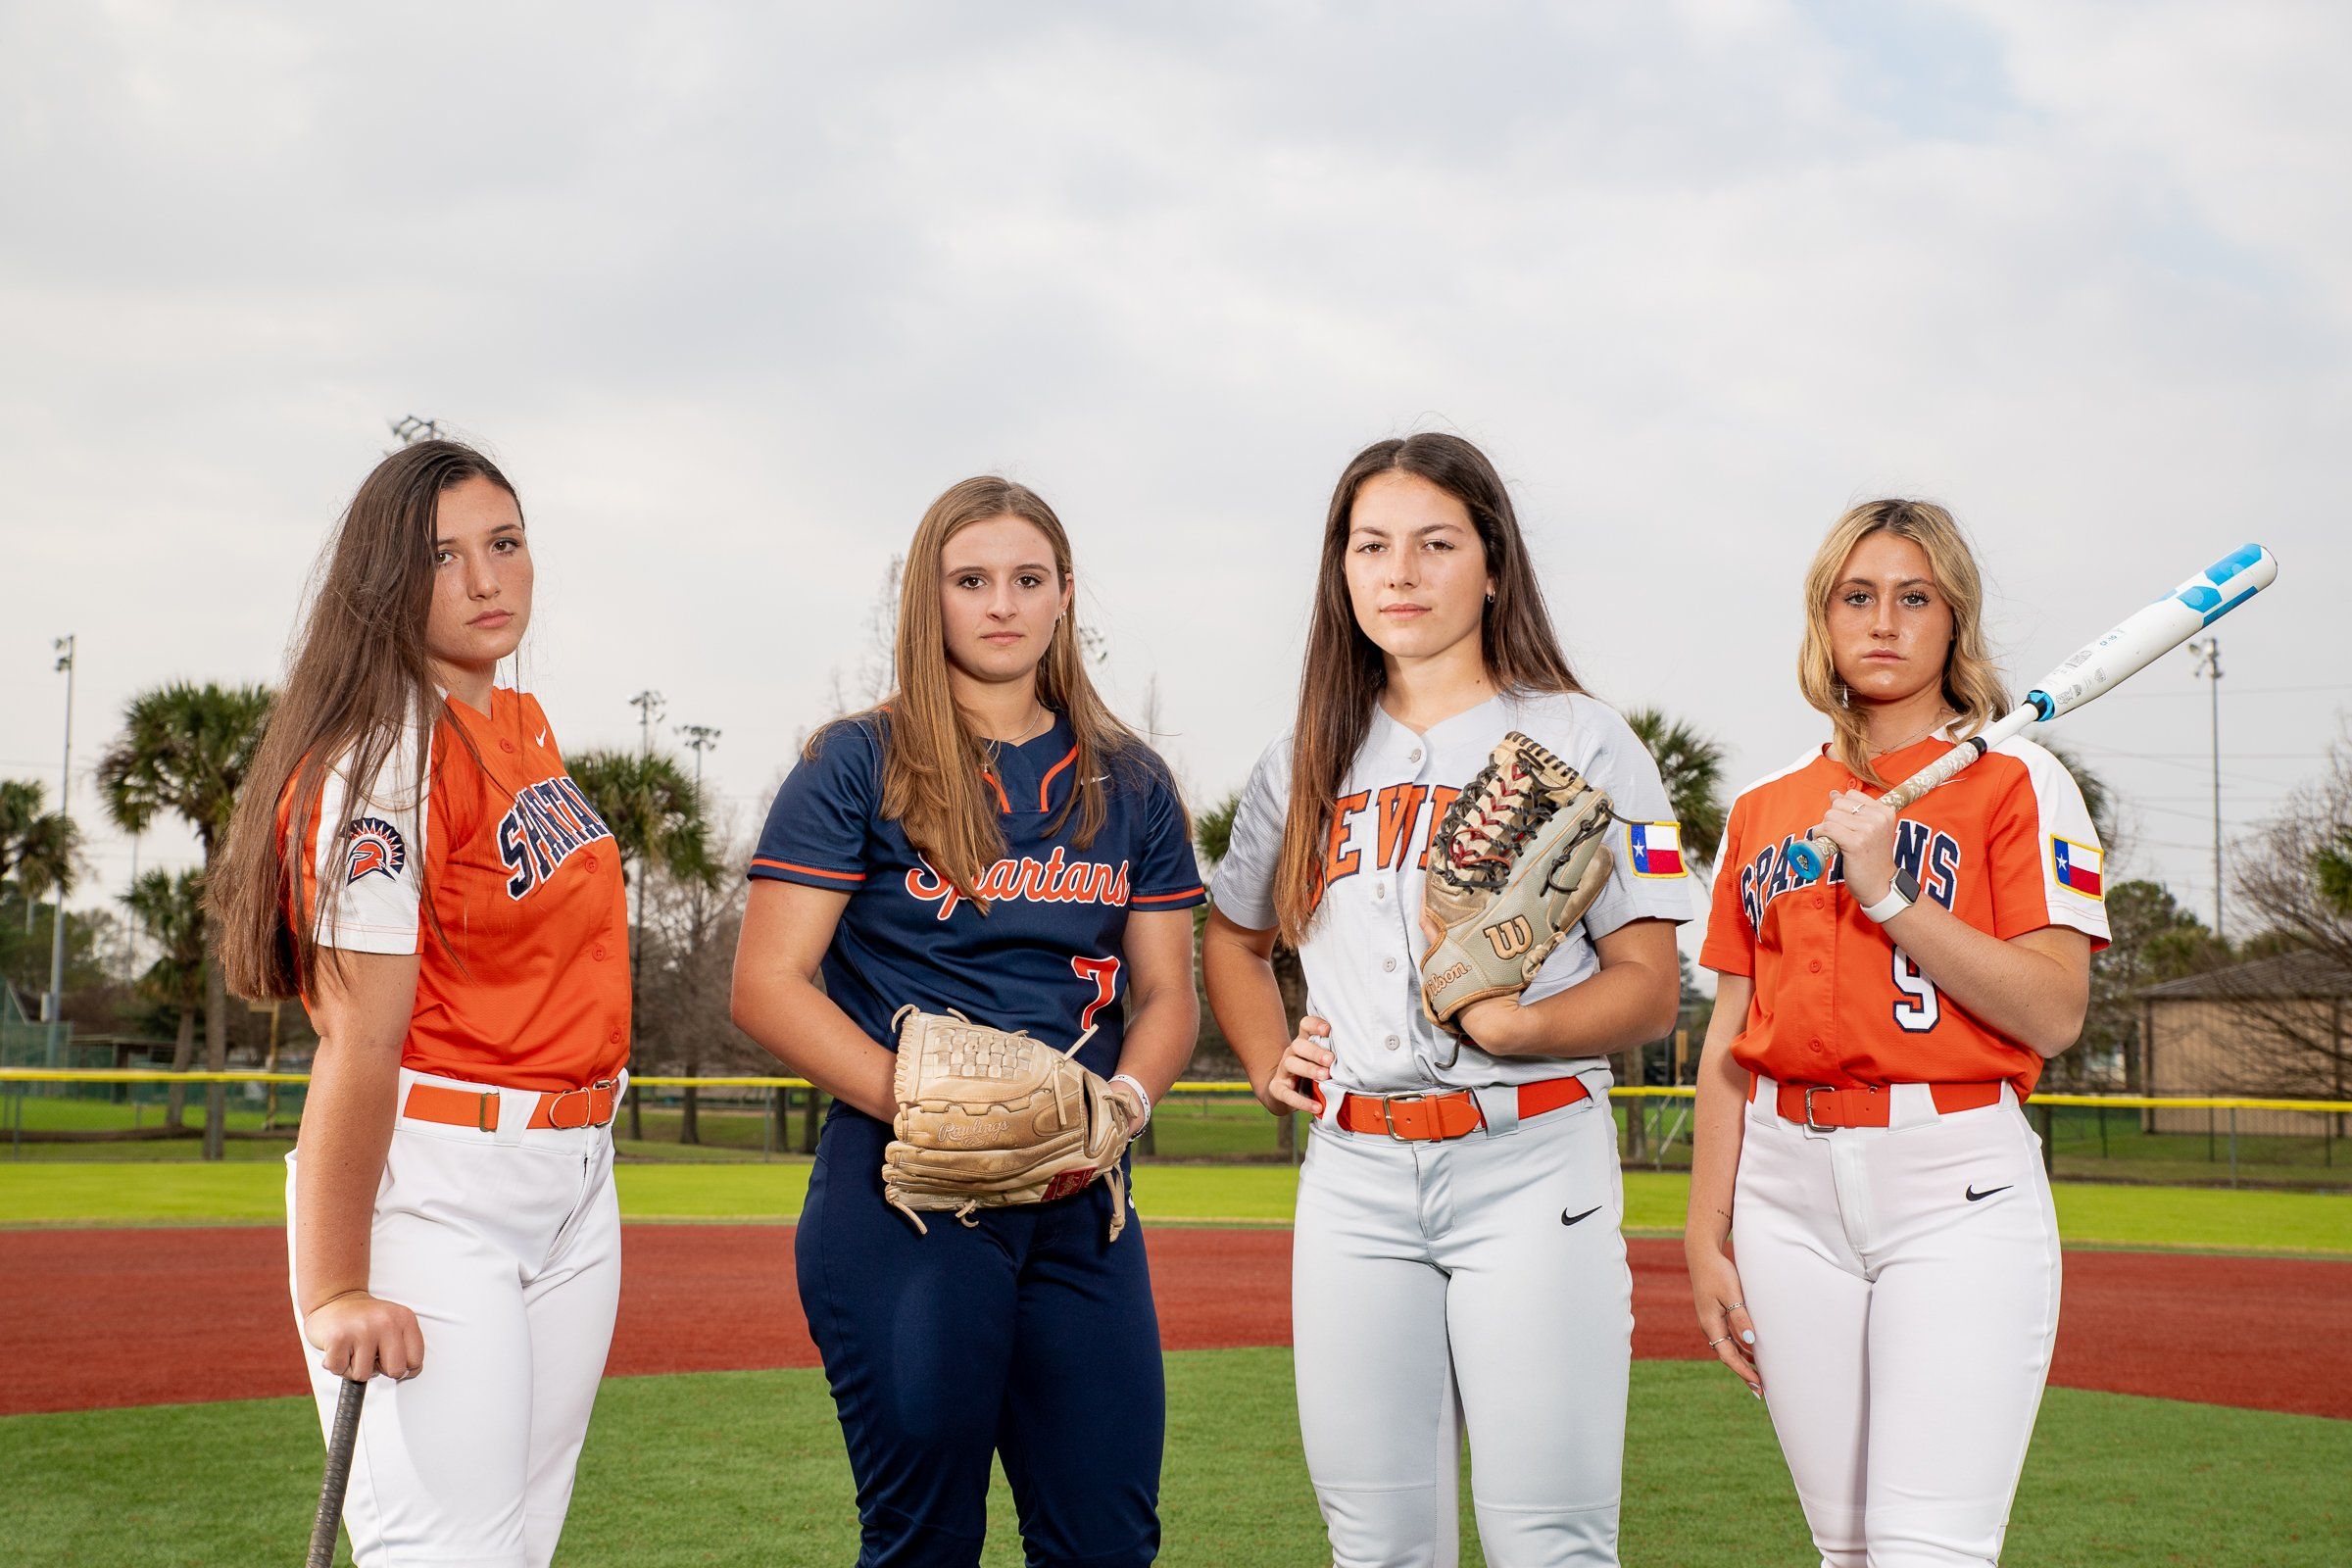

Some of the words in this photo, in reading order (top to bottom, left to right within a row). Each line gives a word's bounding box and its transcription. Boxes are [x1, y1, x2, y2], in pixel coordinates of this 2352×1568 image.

[1740, 818, 1961, 944] SPANS
[1071, 956, 1120, 1032] 7
[1892, 944, 1940, 1034] 9
[938, 1118, 1009, 1147] Rawlings
